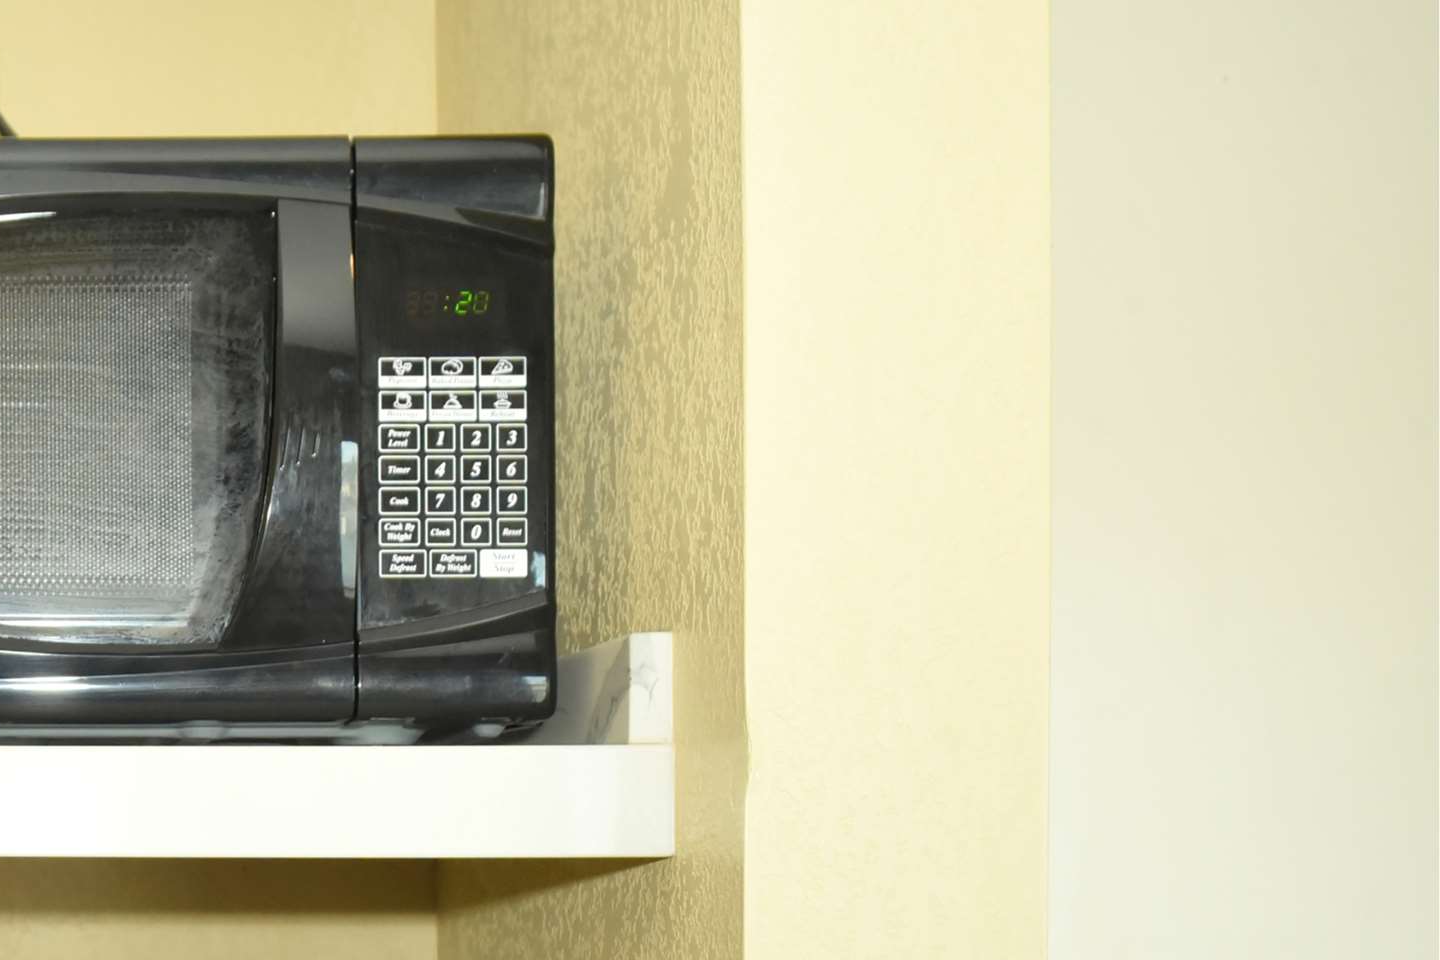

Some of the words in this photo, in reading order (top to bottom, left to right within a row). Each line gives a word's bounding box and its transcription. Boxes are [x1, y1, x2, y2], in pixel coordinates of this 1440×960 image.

[388, 429, 411, 438] Power
[436, 430, 445, 446] 1
[471, 430, 482, 446] 2
[506, 430, 517, 446] 3
[388, 438, 408, 448] Level
[388, 465, 411, 475] Timer
[435, 461, 446, 478] 4
[470, 462, 481, 477] 5
[506, 461, 517, 477] 6
[435, 493, 446, 509] 7
[470, 493, 481, 509] 8
[507, 493, 517, 509] 9
[430, 528, 451, 537] Clock
[471, 524, 482, 540] 0
